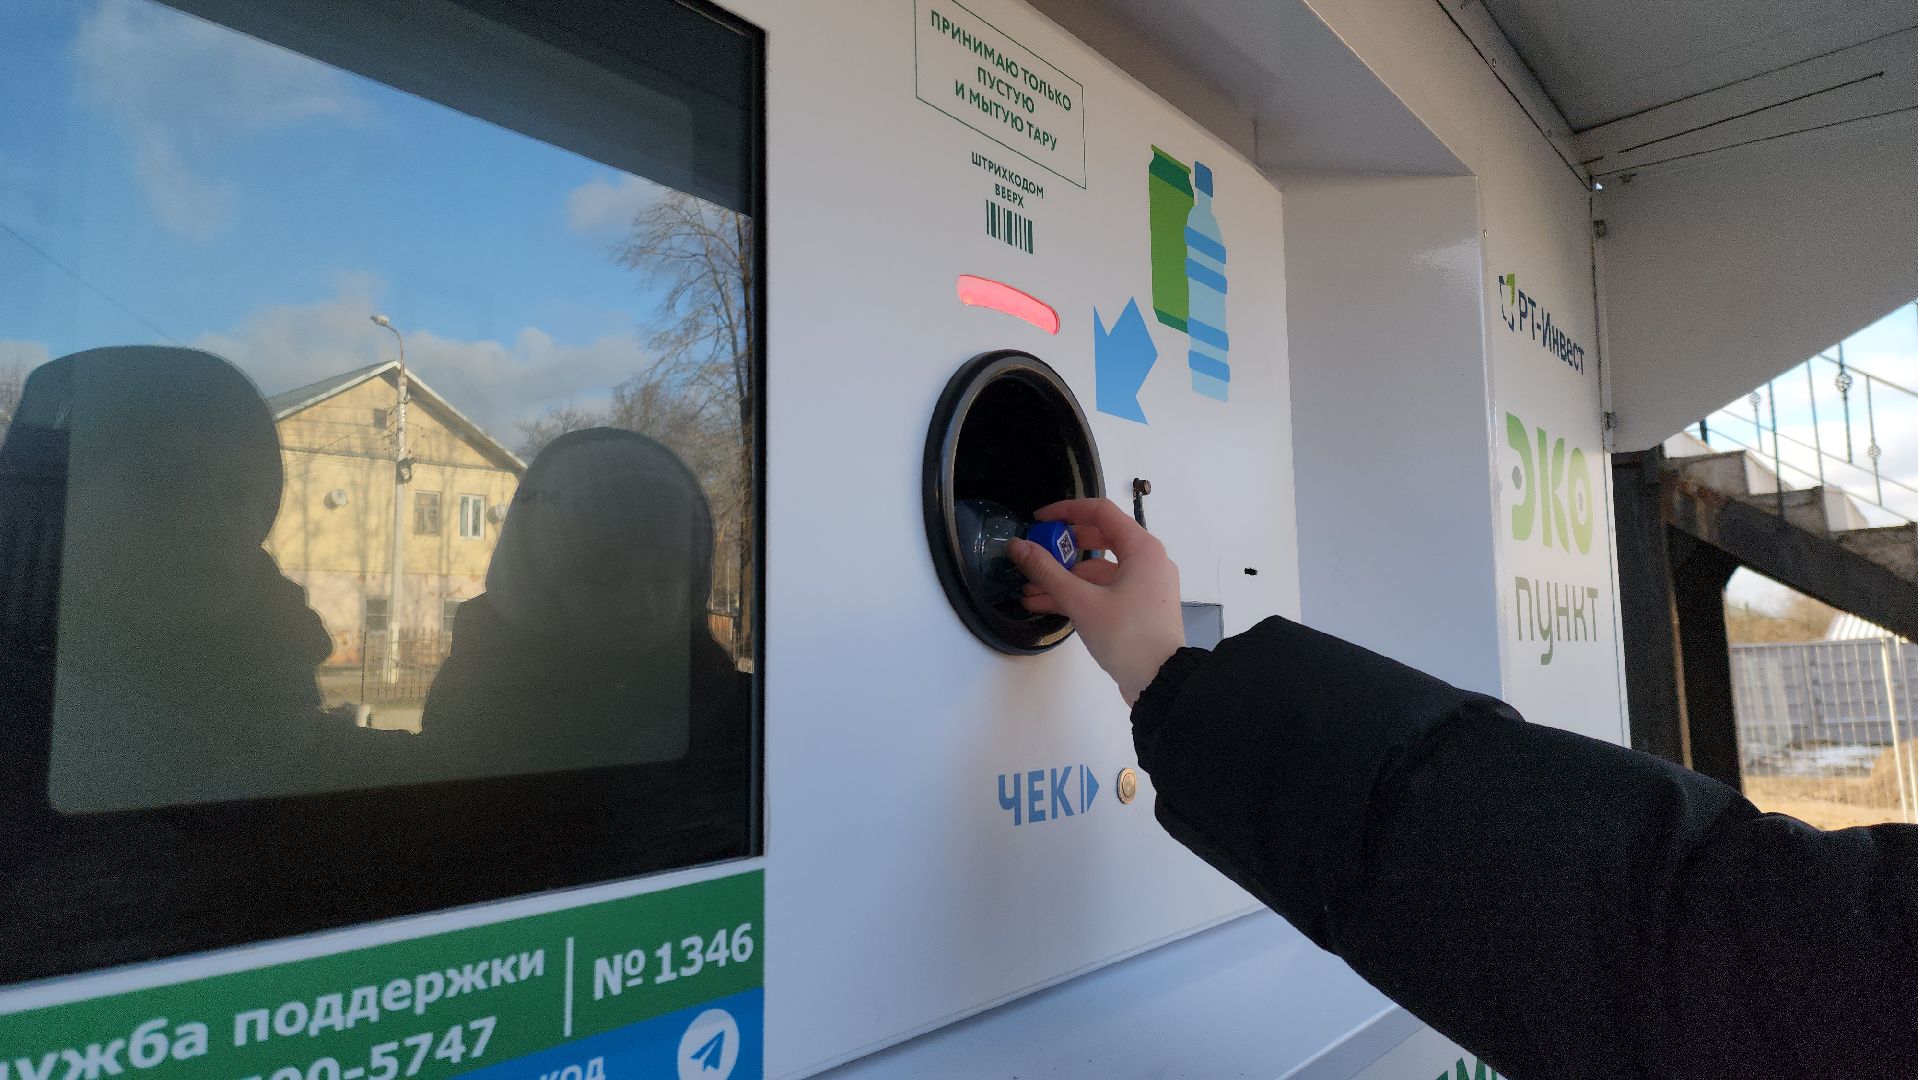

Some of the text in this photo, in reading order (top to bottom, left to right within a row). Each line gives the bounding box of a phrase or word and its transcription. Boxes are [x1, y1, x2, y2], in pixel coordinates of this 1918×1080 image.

[930, 9, 1072, 112] ПРИНИМАЮ ТОЛЬКО
[977, 66, 1035, 114] ПУСТУЮ
[954, 80, 1058, 151] И МЫТУЮ ТАРУ
[971, 152, 1044, 199] ШТРИХКОДОМ
[995, 183, 1024, 208] ВВЕРХ
[1518, 288, 1585, 375] РТ-Инвест
[998, 765, 1075, 826] ЧЕК
[0, 948, 545, 1080] ужба поддержки
